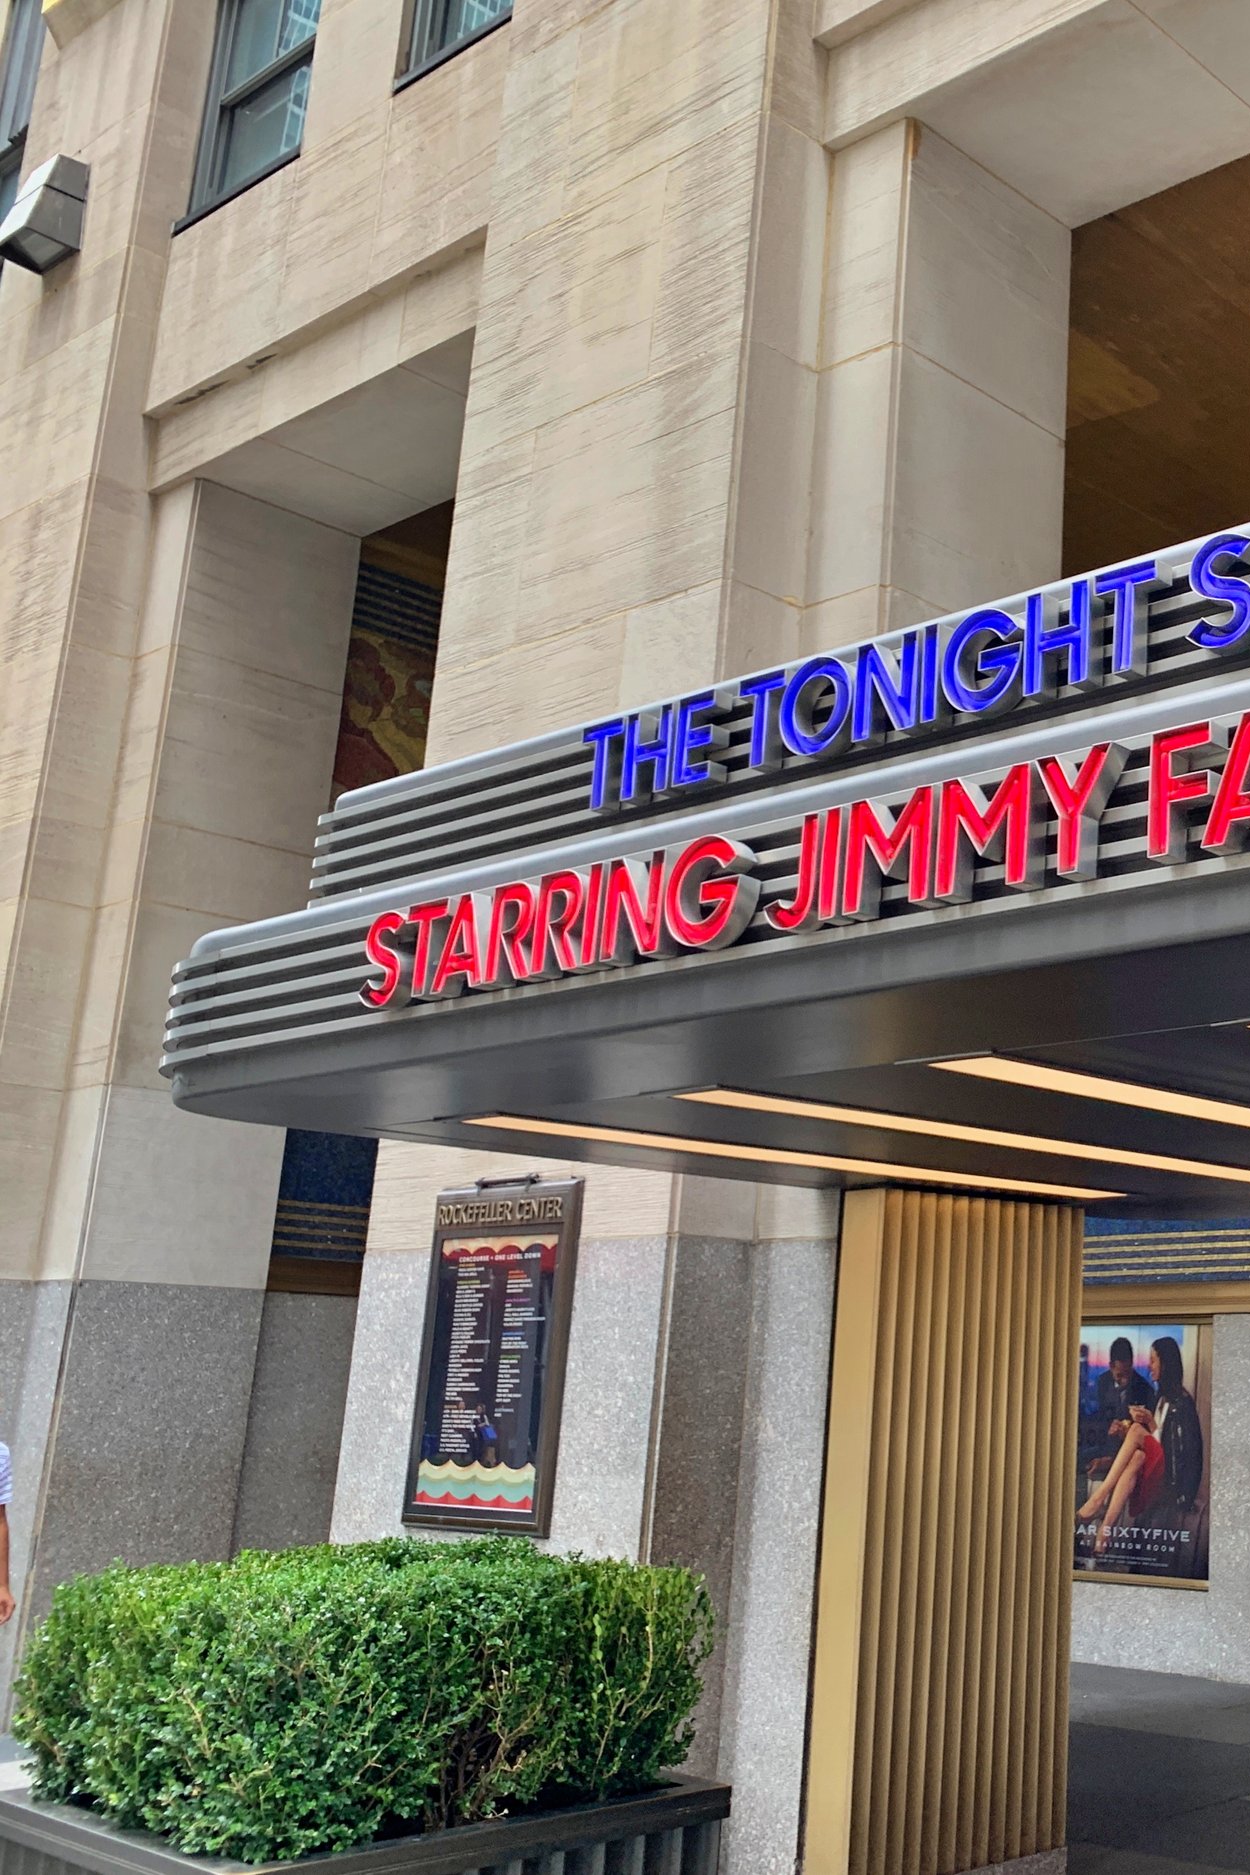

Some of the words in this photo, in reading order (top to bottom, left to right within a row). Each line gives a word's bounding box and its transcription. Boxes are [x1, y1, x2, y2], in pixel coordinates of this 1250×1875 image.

[582, 688, 727, 811] THE
[739, 558, 1164, 758] TONIGHT
[359, 834, 755, 1008] STARRING
[764, 742, 1118, 932] JIMMY
[439, 1200, 512, 1225] ROCKEFELLER
[515, 1196, 562, 1220] CENTER
[458, 1254, 490, 1263] CONCOURSE
[506, 1252, 524, 1260] LEVEL
[524, 1251, 541, 1259] DOWN
[1074, 1524, 1097, 1536] AR
[1103, 1525, 1190, 1542] SIXTYFIVE
[1146, 1543, 1175, 1552] ROOM
